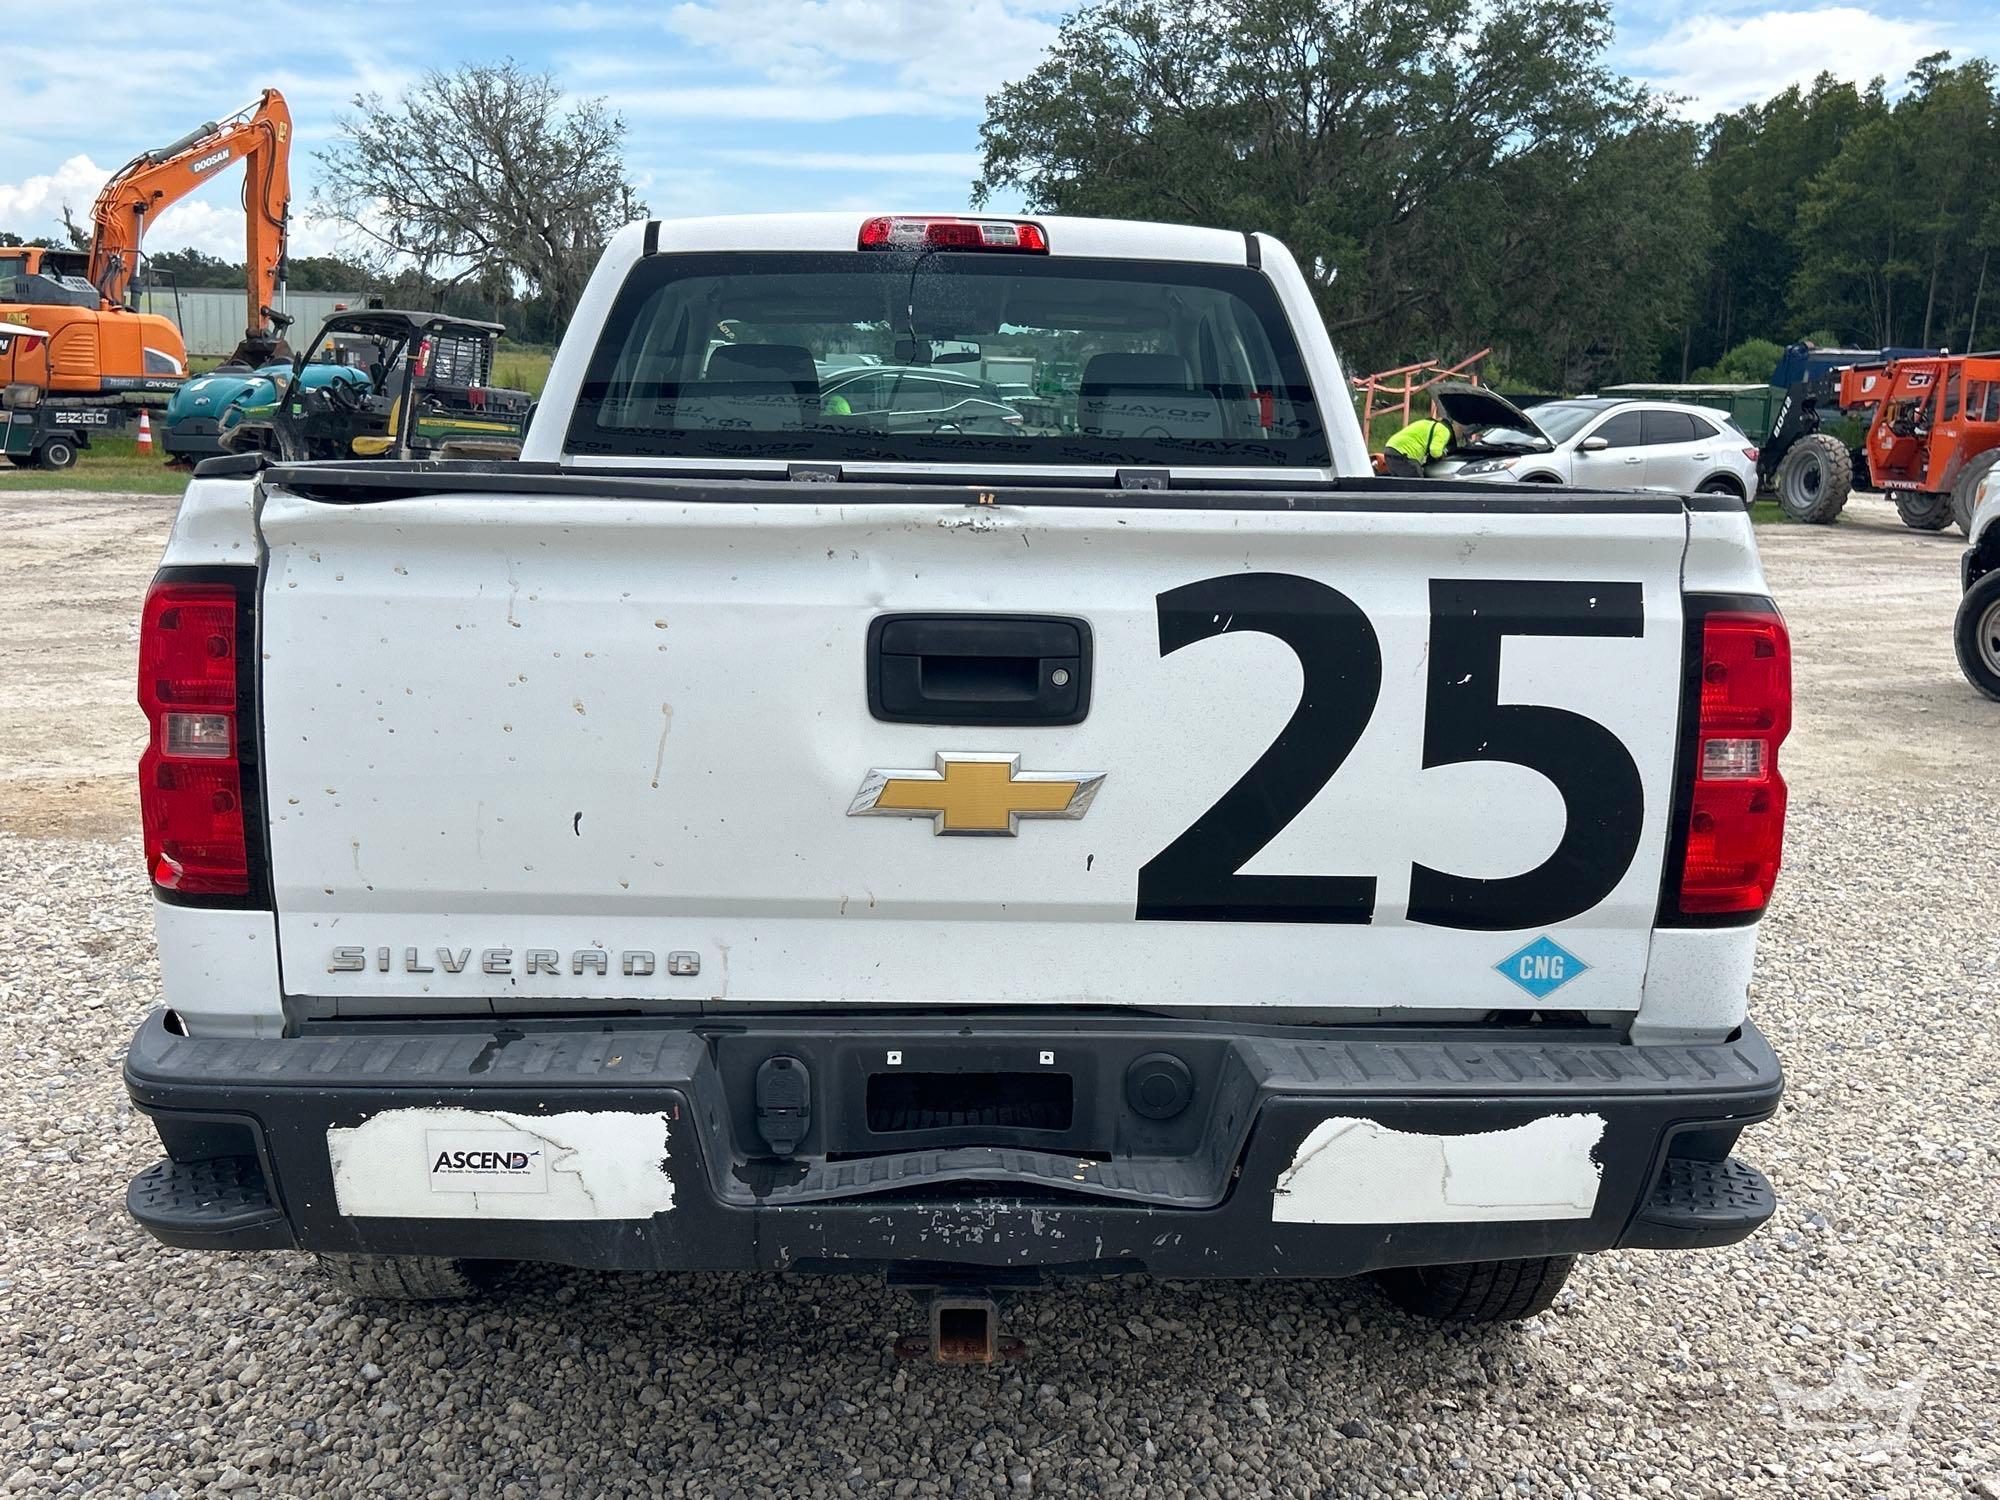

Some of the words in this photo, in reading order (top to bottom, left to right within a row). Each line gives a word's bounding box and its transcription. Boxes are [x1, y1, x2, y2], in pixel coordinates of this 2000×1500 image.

[194, 149, 230, 173] DOOSAN
[1135, 571, 1645, 932] 25
[331, 945, 702, 977] SILVERADO
[1519, 955, 1565, 980] CNG
[432, 1151, 529, 1172] ASCEND
